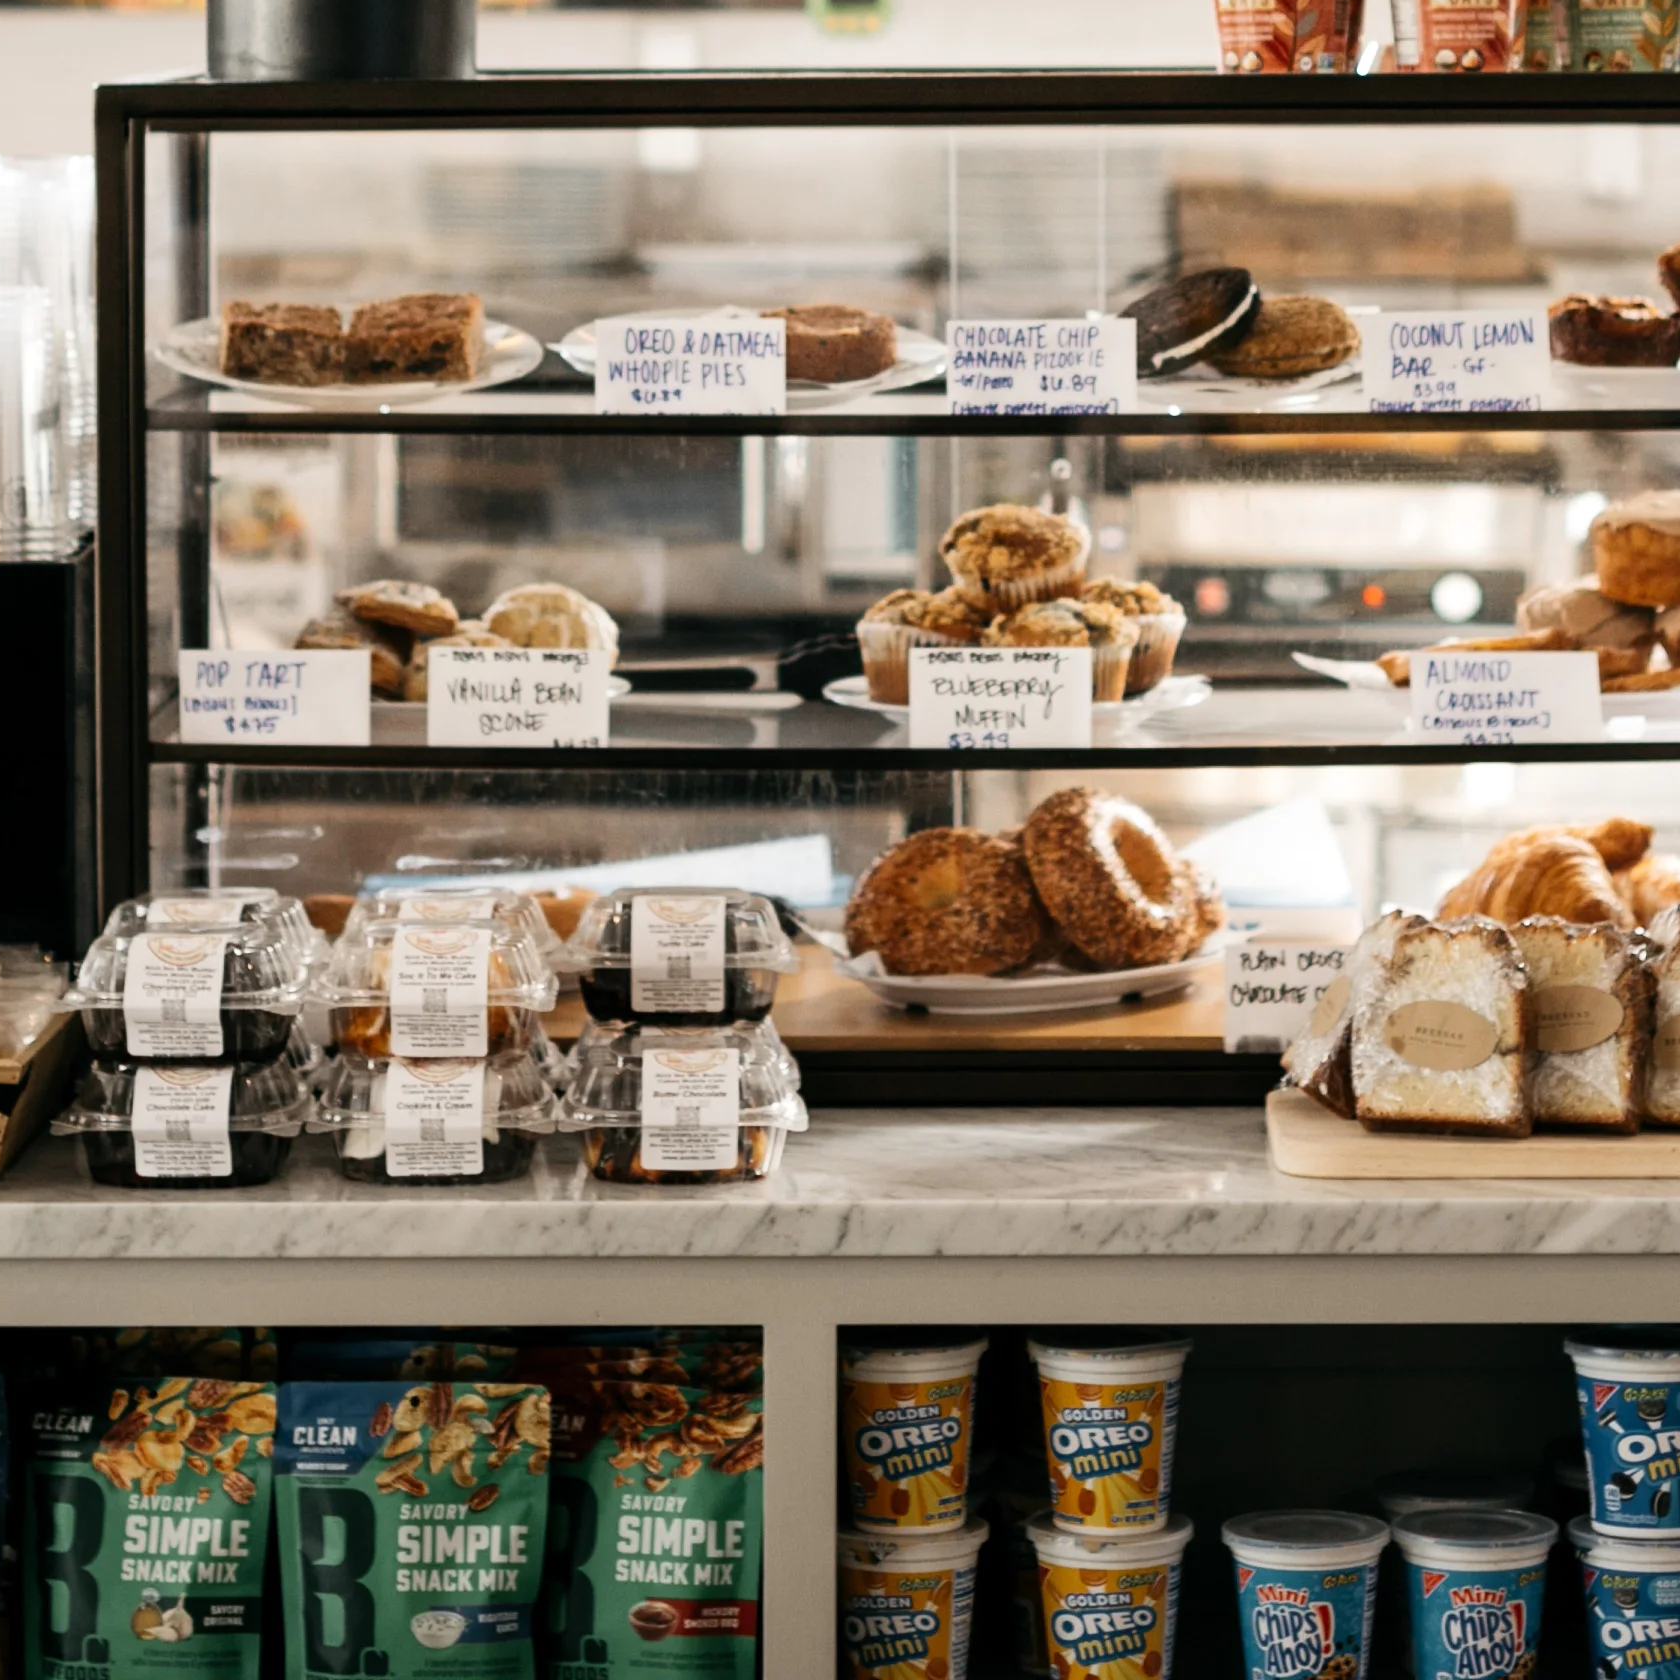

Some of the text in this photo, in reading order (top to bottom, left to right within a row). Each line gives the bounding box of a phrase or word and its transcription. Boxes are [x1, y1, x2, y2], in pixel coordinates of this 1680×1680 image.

[626, 328, 783, 357] OREO & OATMEAL
[955, 325, 1099, 348] CHOCOLATE CHIP
[1391, 318, 1534, 350] COCONUT LEMON
[954, 350, 1104, 370] BANANA PIZOOKIE
[1392, 354, 1435, 379] BAR
[609, 360, 746, 389] WHOOPIE PIES
[197, 661, 307, 688] POP TART
[1427, 660, 1511, 688] ALMOND
[448, 679, 582, 704] VANILLA BEAN
[932, 674, 1064, 719] BLUEBERRY
[1436, 690, 1539, 711] CROISSANT
[480, 710, 548, 735] SCONE
[955, 704, 1026, 729] MUFFIN
[143, 983, 186, 991] Chocolate
[32, 1413, 93, 1433] CLEAN
[875, 1405, 940, 1422] GOLDEN
[1062, 1408, 1126, 1422] GOLDEN
[293, 1426, 357, 1446] CLEAN
[861, 1422, 961, 1458] OREO
[1052, 1425, 1151, 1456] OREO
[887, 1444, 950, 1477] mini
[1072, 1448, 1139, 1476] mini
[128, 1494, 195, 1513] SAVORY
[399, 1504, 469, 1520] SAVORY
[621, 1494, 687, 1513] SAVORY
[123, 1514, 251, 1557] SIMPLE
[396, 1525, 529, 1564] SIMPLE
[617, 1515, 745, 1558] SIMPLE
[121, 1558, 239, 1584] SNACK MIX
[396, 1570, 518, 1592] SNACK MIX
[615, 1559, 734, 1586] SNACK MIX
[852, 1595, 912, 1610] GOLDEN
[1066, 1593, 1132, 1608] GOLDEN
[1257, 1585, 1308, 1606] Mini
[1450, 1587, 1507, 1608] Mini
[203, 1616, 243, 1626] ORIGINAL
[210, 1605, 245, 1615] SAVORY
[701, 1607, 740, 1617] HICKORY
[845, 1613, 937, 1640] OREO
[1054, 1609, 1155, 1640] OREO
[1255, 1607, 1319, 1648] Chips
[1444, 1609, 1513, 1650] Chips
[862, 1635, 924, 1664] mini
[1077, 1632, 1142, 1661] mini
